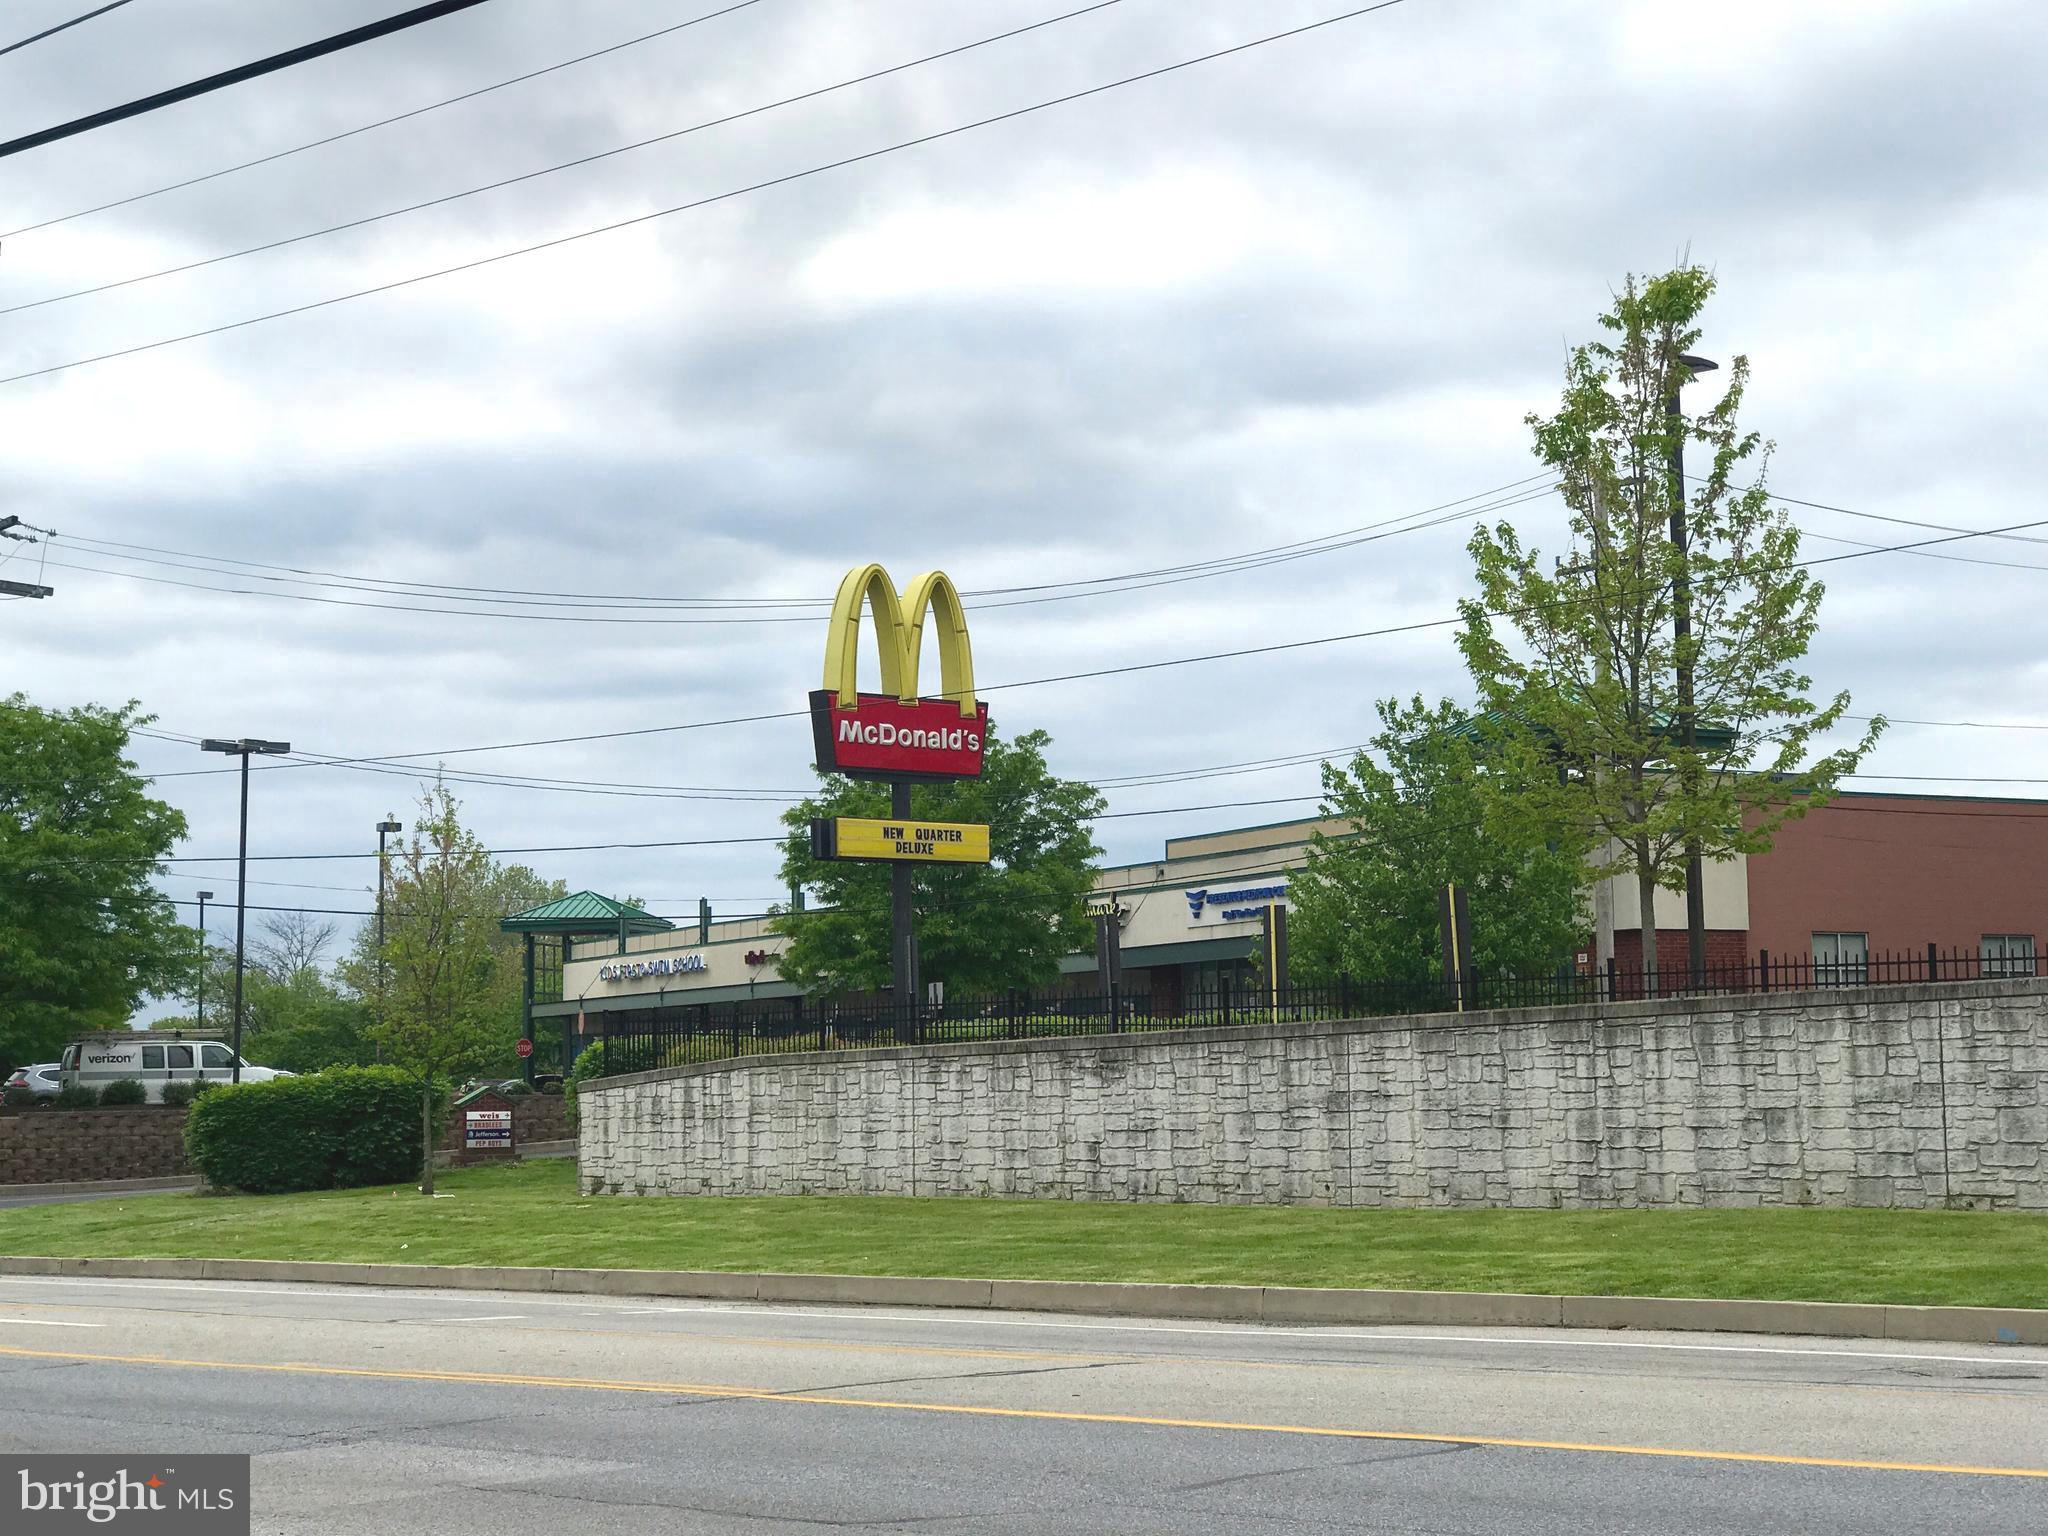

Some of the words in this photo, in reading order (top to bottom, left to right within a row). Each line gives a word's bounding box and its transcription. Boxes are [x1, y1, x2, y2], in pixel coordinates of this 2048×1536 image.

[838, 719, 980, 752] McDonald's
[883, 827, 904, 839] NEW
[915, 828, 962, 842] QUARTER
[896, 842, 934, 855] DELUXE
[648, 959, 671, 976] SWIM
[673, 954, 704, 973] SCHOOL
[517, 1044, 532, 1052] STOP
[88, 1053, 131, 1063] verizon
